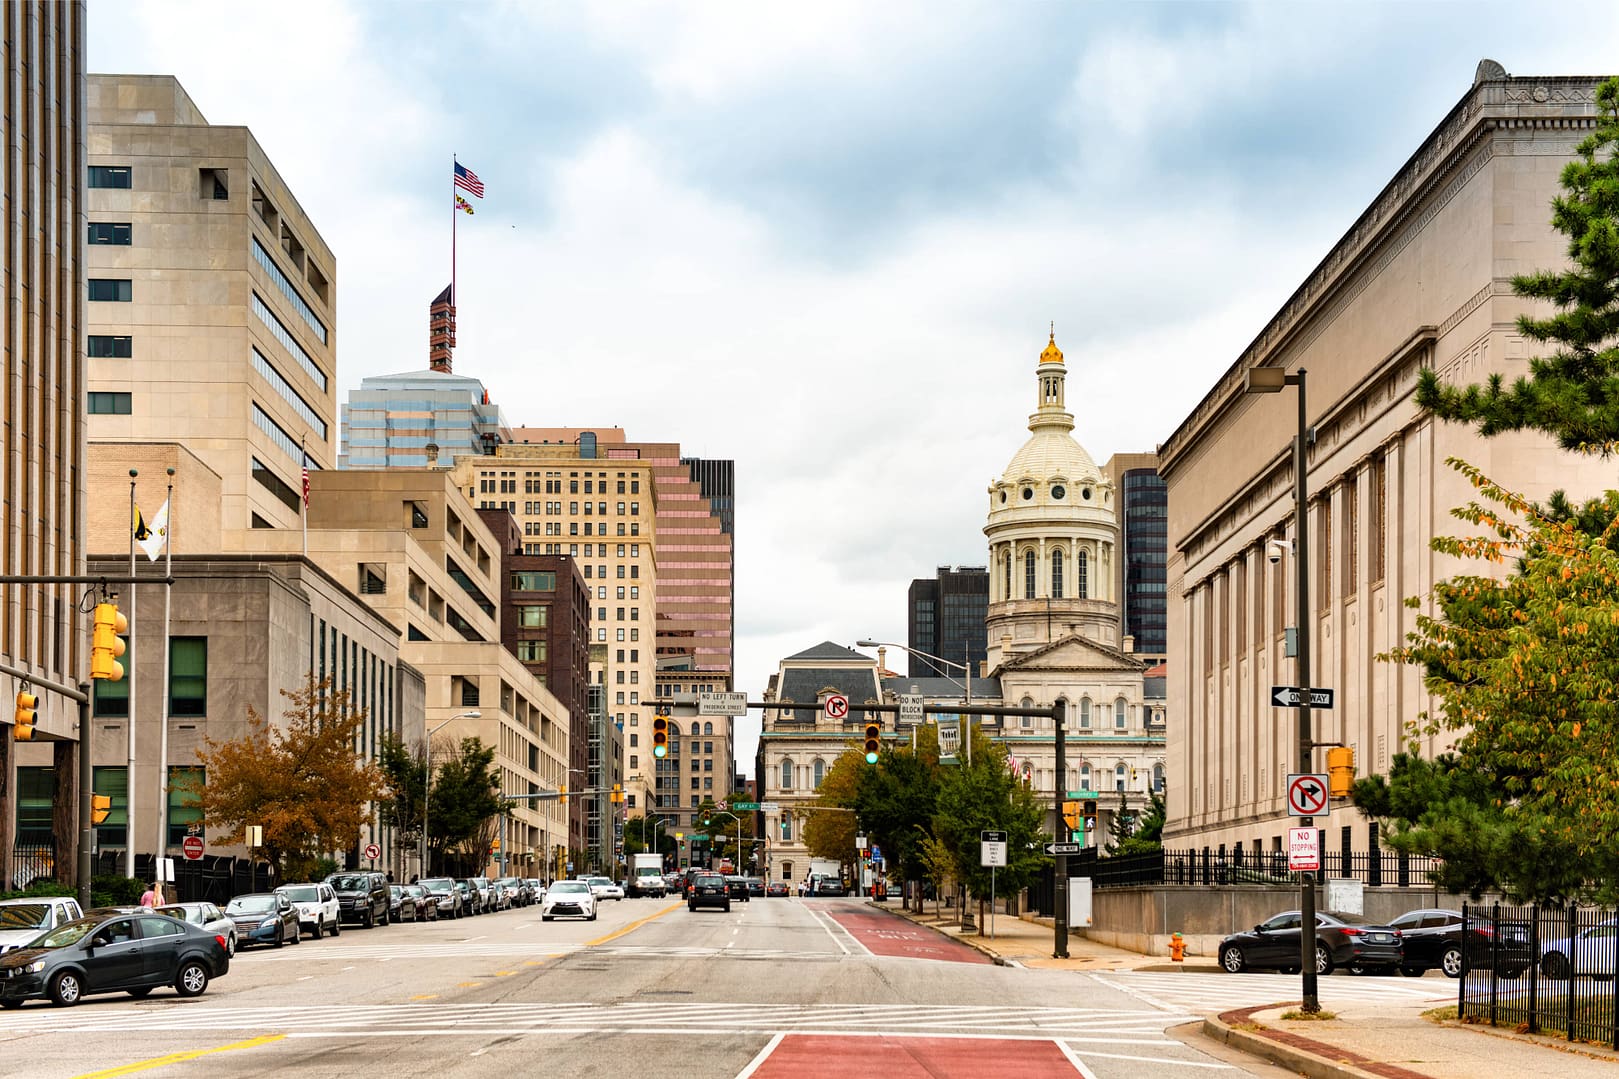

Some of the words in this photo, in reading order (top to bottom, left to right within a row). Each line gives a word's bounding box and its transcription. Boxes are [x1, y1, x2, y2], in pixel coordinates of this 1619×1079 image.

[1310, 694, 1327, 703] WAY
[1297, 831, 1310, 840] NO
[1291, 843, 1317, 851] STOPPING
